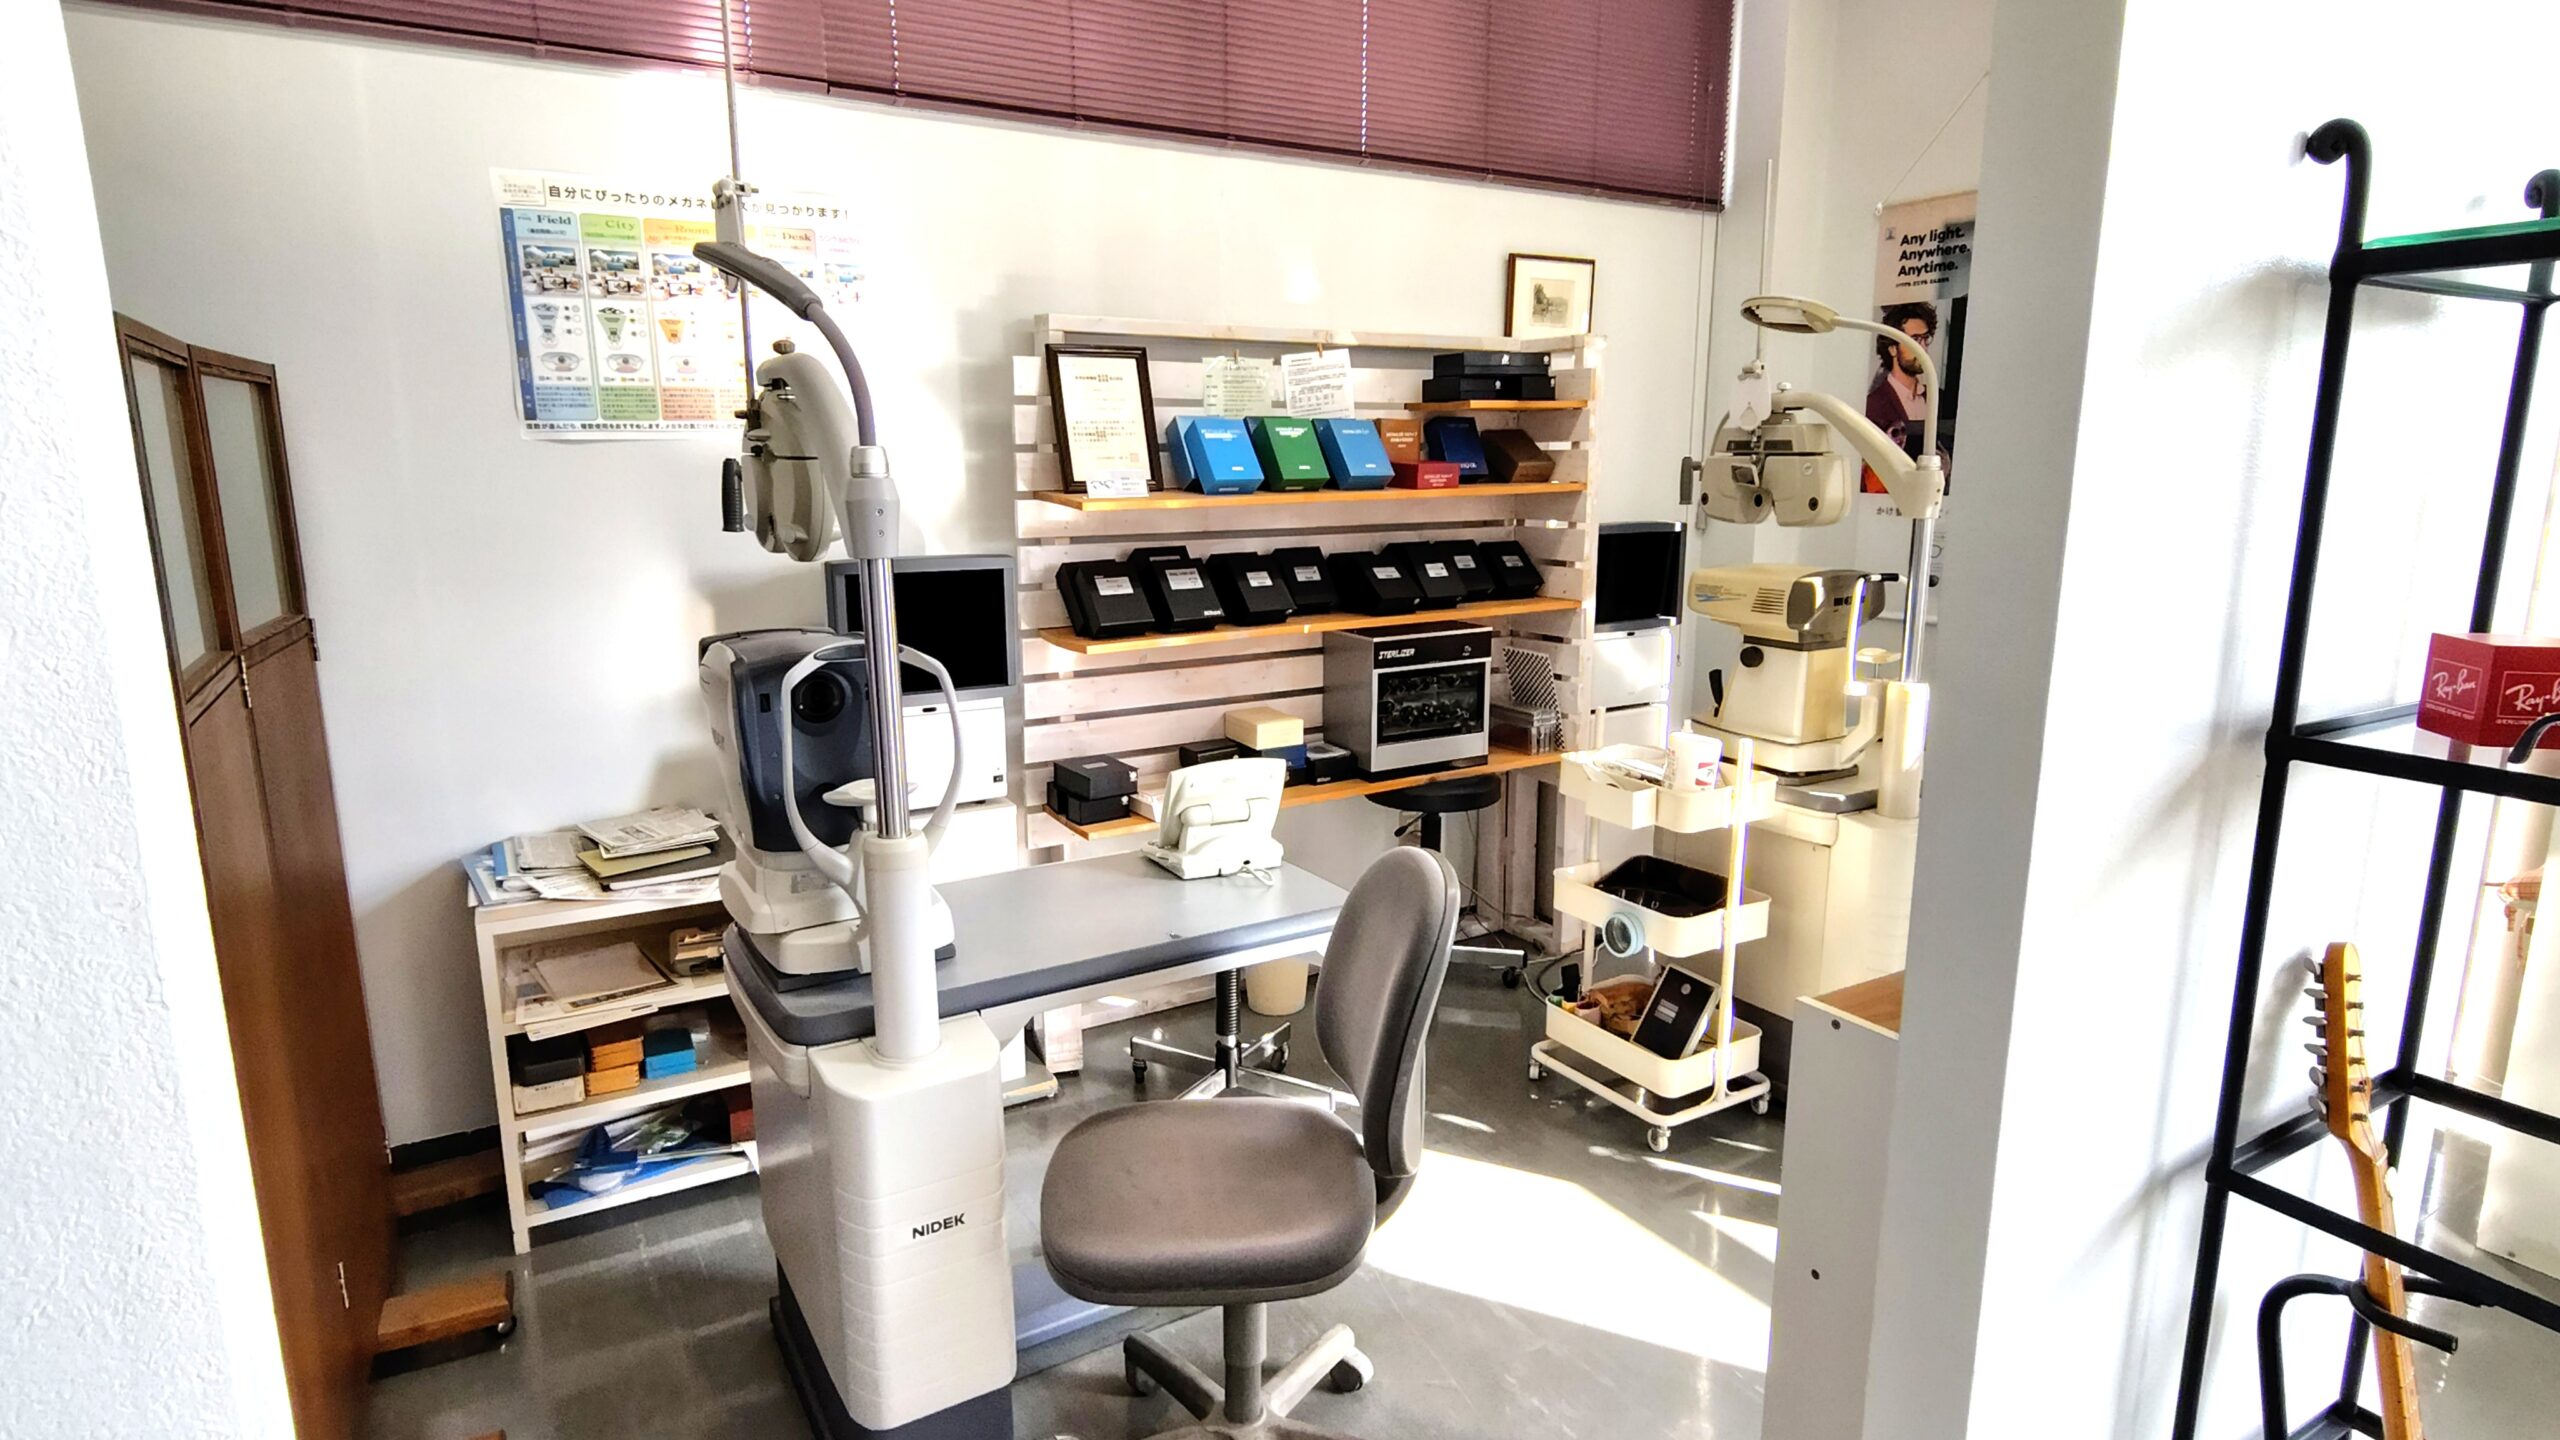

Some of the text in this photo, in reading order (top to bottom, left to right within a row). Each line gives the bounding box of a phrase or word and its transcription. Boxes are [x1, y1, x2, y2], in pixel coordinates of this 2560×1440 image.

[537, 214, 572, 226] Field
[605, 219, 635, 231] City
[1900, 234, 1927, 246] Any
[1899, 243, 1970, 261] Anywhere.
[1898, 260, 1959, 277] Anytime.
[2432, 668, 2476, 701] Ray-Ban
[912, 1212, 965, 1239] NIDEK
